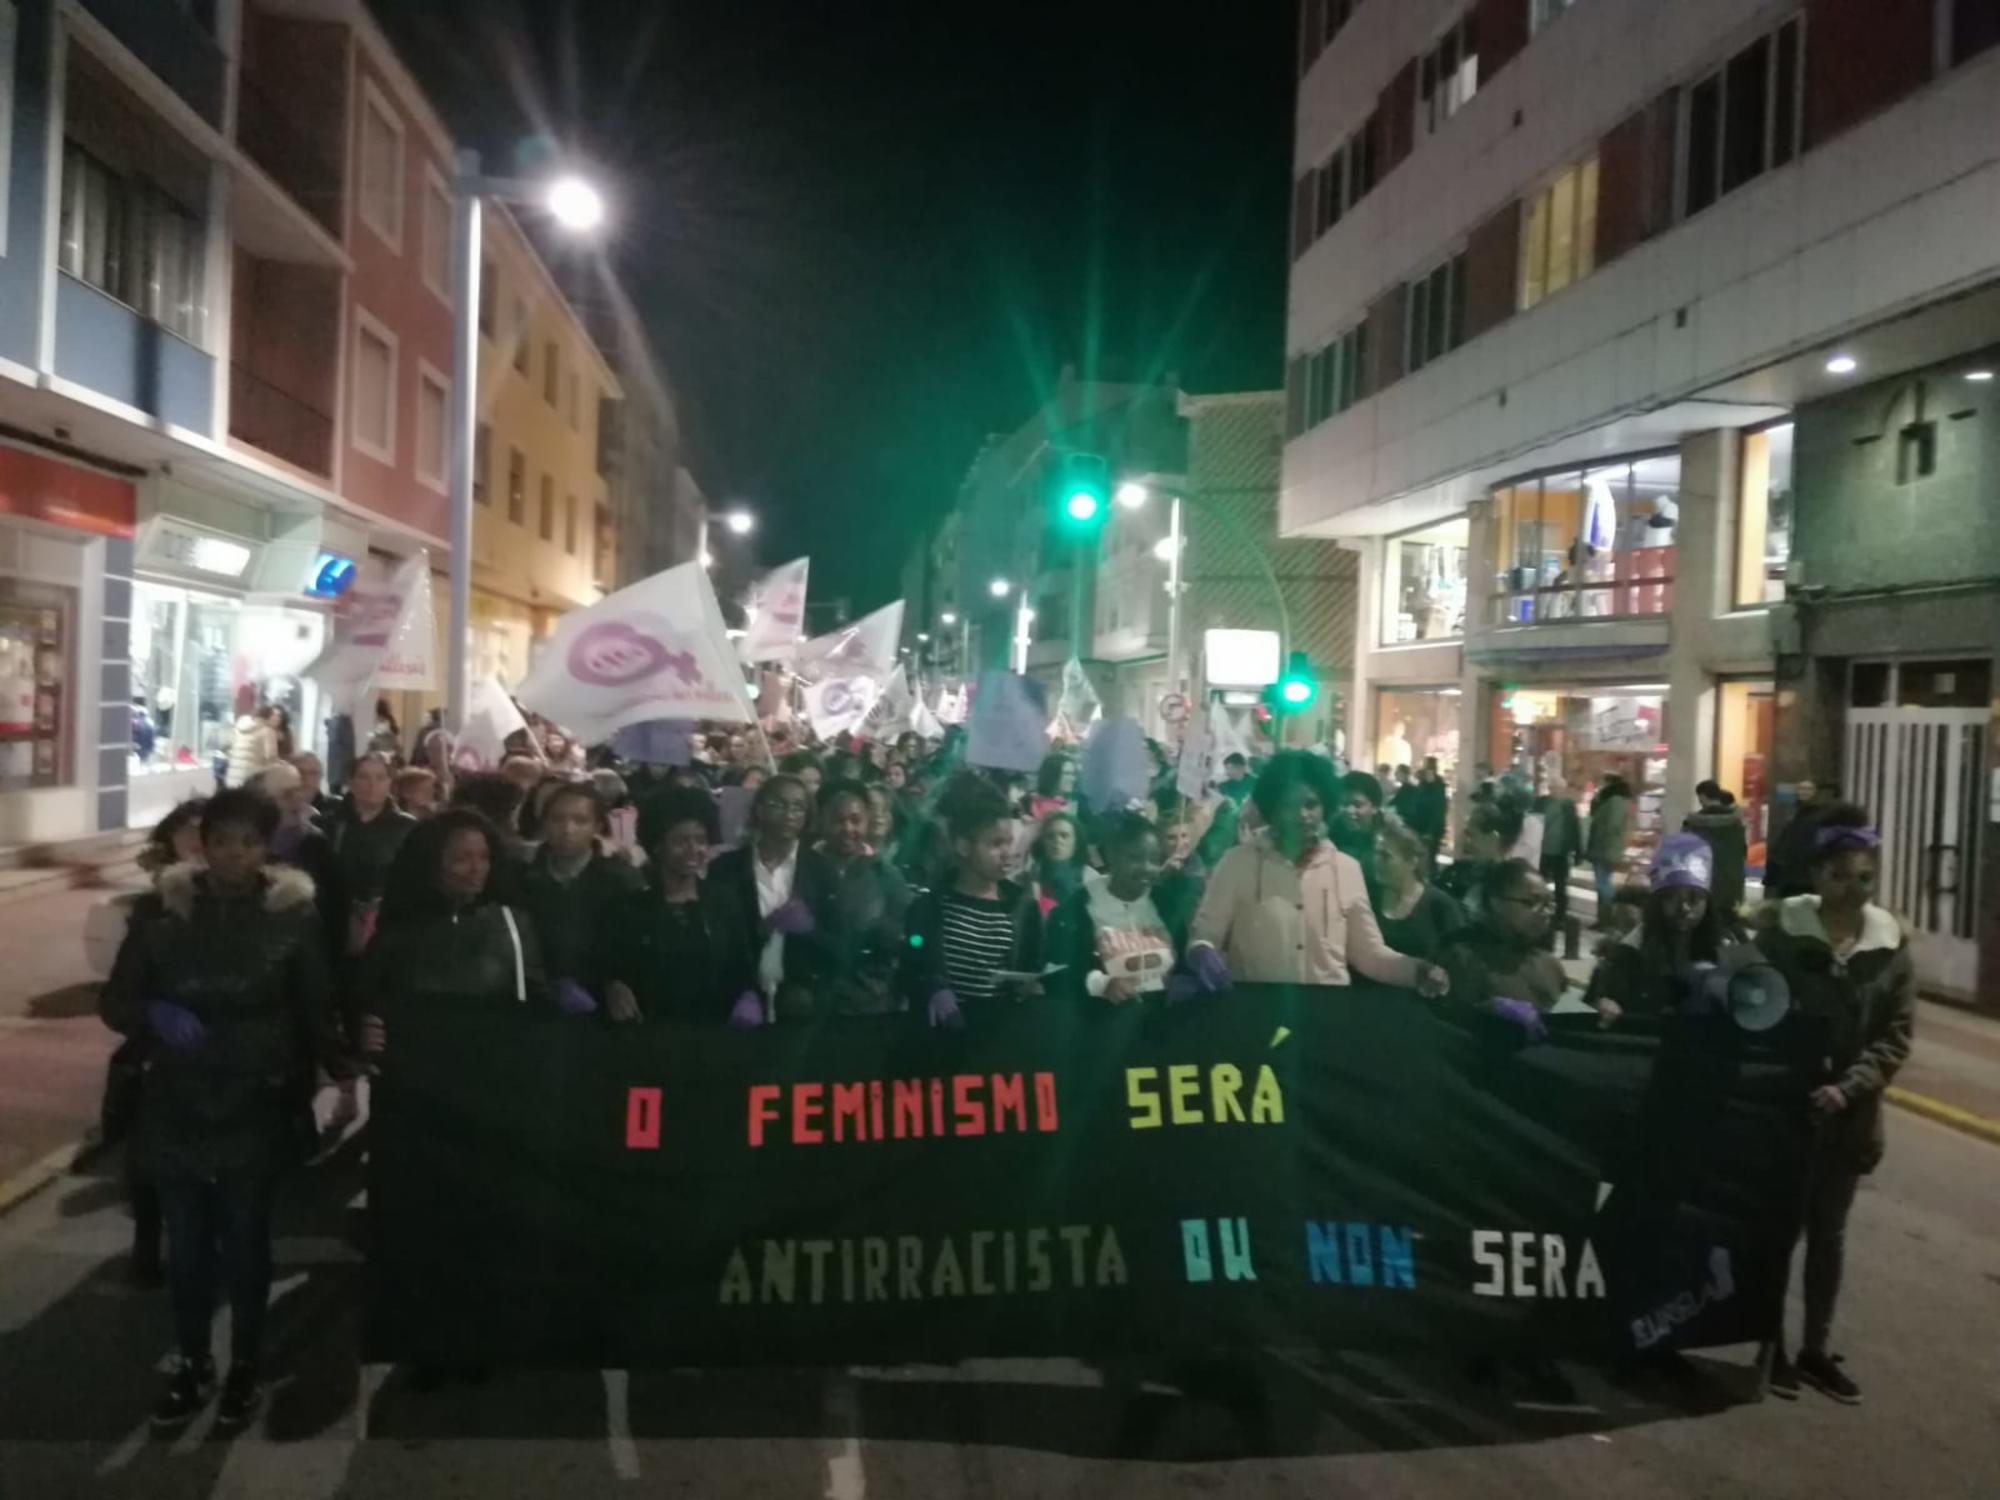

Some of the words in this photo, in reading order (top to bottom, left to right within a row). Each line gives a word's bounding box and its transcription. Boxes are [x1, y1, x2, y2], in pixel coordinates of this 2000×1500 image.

[626, 1087, 662, 1148] O
[1126, 1027, 1290, 1128] SERÁ
[719, 1225, 1129, 1304] ANTIRRACISTA
[1182, 1217, 1257, 1281] OU
[1307, 1223, 1415, 1288] NON
[1472, 1182, 1612, 1297] SERÁ
